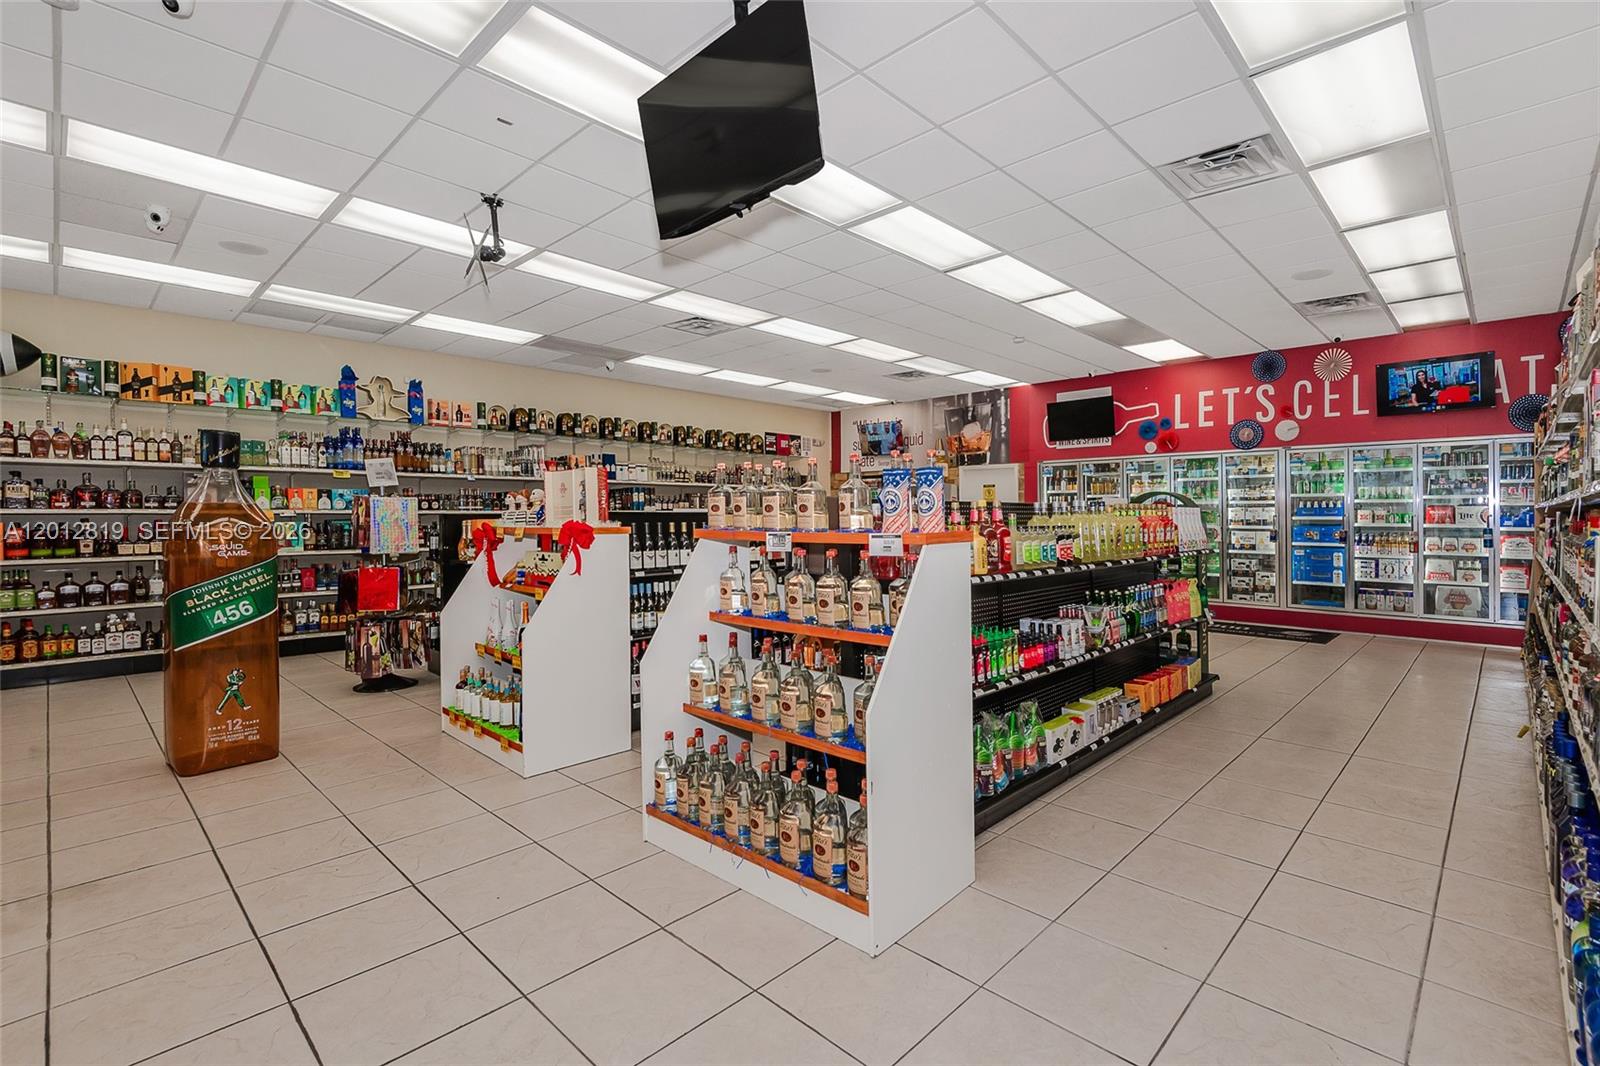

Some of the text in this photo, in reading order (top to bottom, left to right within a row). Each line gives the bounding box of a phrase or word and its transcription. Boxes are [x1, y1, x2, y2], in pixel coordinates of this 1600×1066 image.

[1175, 384, 1275, 429] LET'S
[1459, 512, 1474, 520] Lite
[208, 541, 244, 552] SQUID
[217, 550, 251, 559] GAME
[191, 579, 230, 597] JOHNNIE
[185, 586, 231, 608] BLACK
[213, 600, 254, 625] 456
[226, 718, 243, 731] 12
